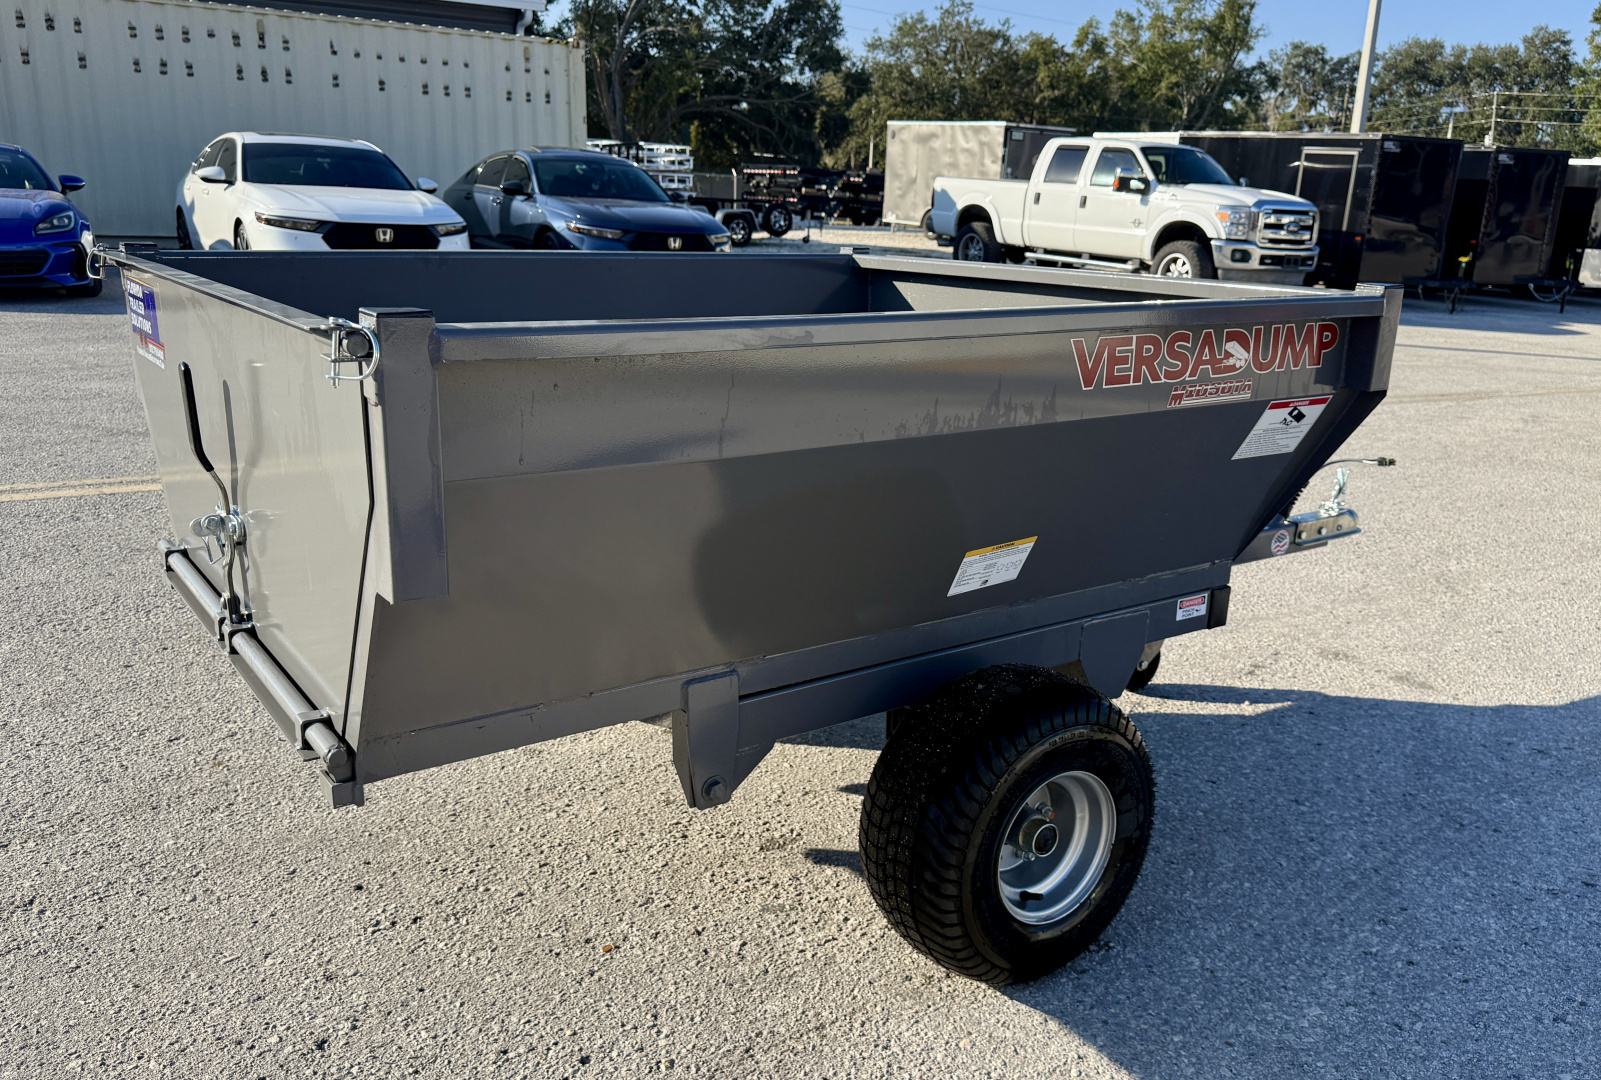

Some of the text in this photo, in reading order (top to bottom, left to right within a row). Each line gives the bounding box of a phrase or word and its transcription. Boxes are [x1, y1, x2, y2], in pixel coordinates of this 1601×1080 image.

[128, 296, 145, 315] TRAILER
[131, 312, 152, 335] SOLUTIONS
[1070, 321, 1340, 390] VERSADUMP
[1167, 378, 1253, 407] MIDSOTA
